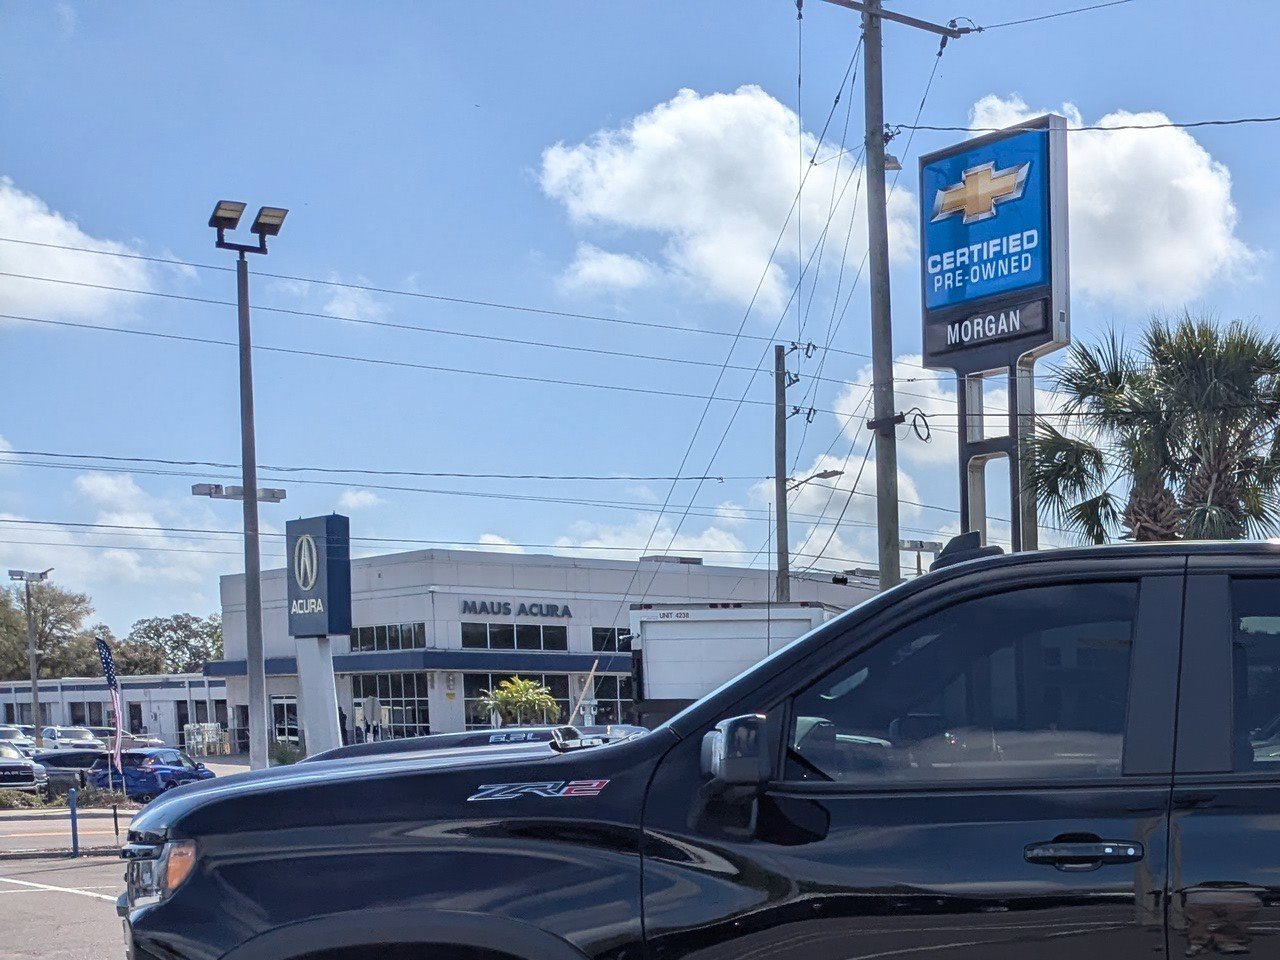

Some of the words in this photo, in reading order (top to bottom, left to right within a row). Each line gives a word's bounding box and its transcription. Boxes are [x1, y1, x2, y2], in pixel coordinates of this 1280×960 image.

[927, 229, 1038, 274] CERTIFIED
[934, 252, 1032, 292] PRE-OWNED
[947, 309, 1020, 345] MORGAN
[291, 598, 324, 614] ACURA
[462, 600, 511, 615] MAUS
[517, 602, 573, 618] ACURA
[467, 779, 611, 801] ZR2
